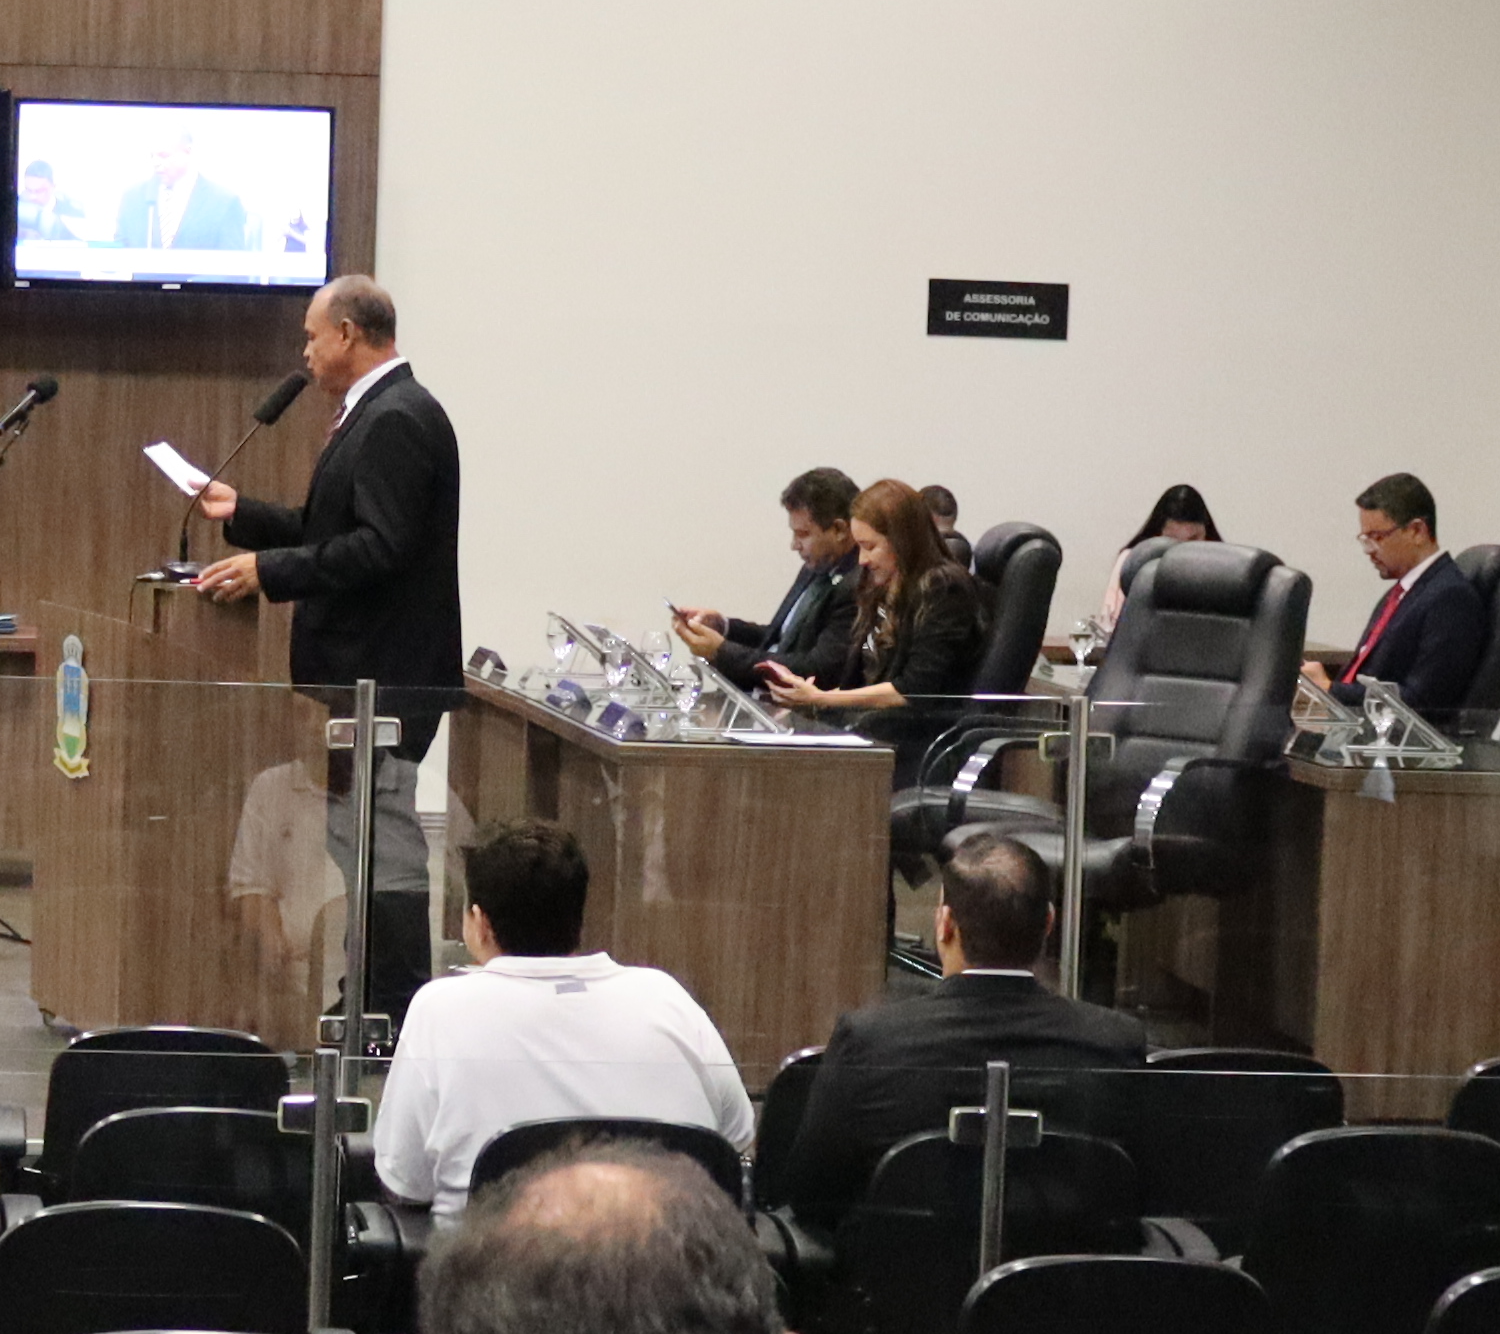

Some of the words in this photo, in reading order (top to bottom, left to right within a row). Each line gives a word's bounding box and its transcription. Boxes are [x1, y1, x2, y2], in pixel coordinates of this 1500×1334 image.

[963, 293, 1036, 306] ASSESSORIA
[945, 310, 961, 322] DE
[963, 311, 1050, 327] COMUNICAÇÃO
